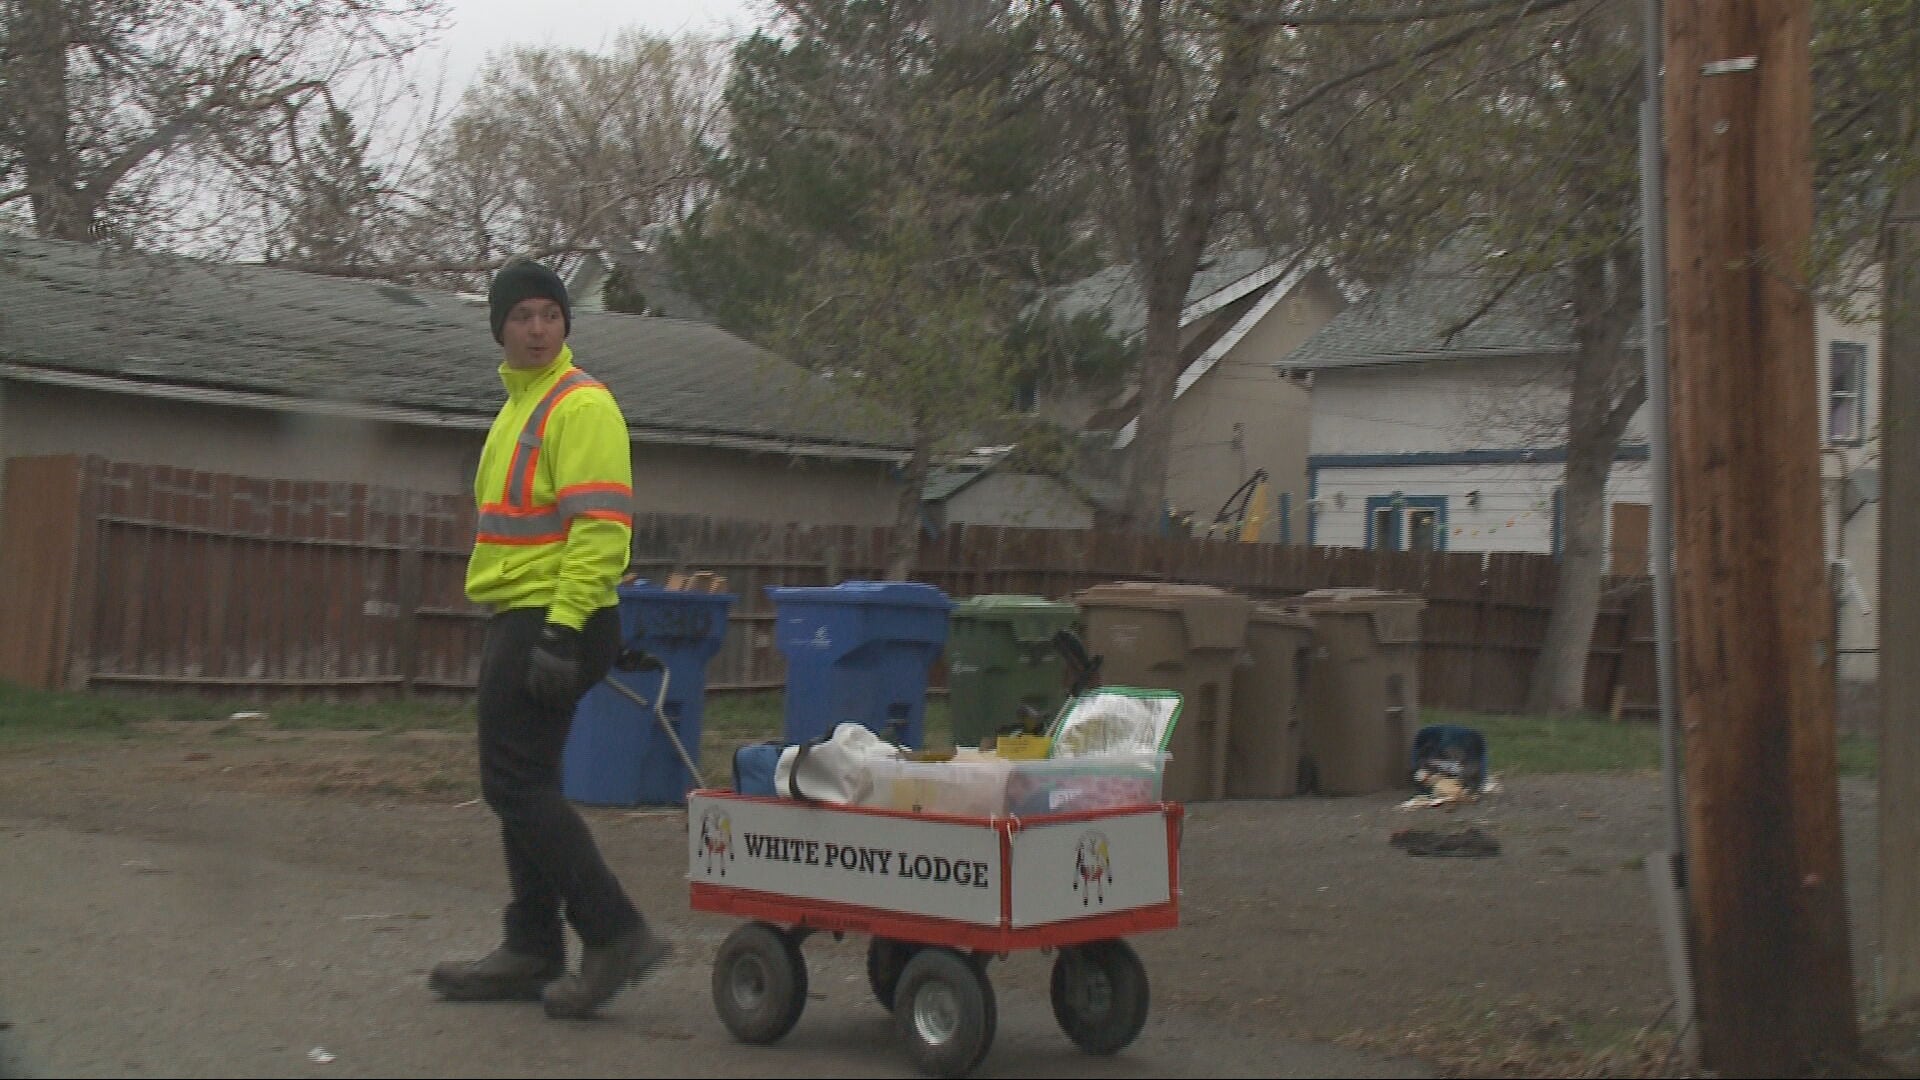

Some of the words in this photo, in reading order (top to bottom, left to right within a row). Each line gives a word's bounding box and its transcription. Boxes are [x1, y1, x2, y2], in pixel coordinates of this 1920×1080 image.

[744, 833, 819, 865] WHITE
[825, 844, 892, 874] PONY
[898, 853, 988, 888] LODGE
